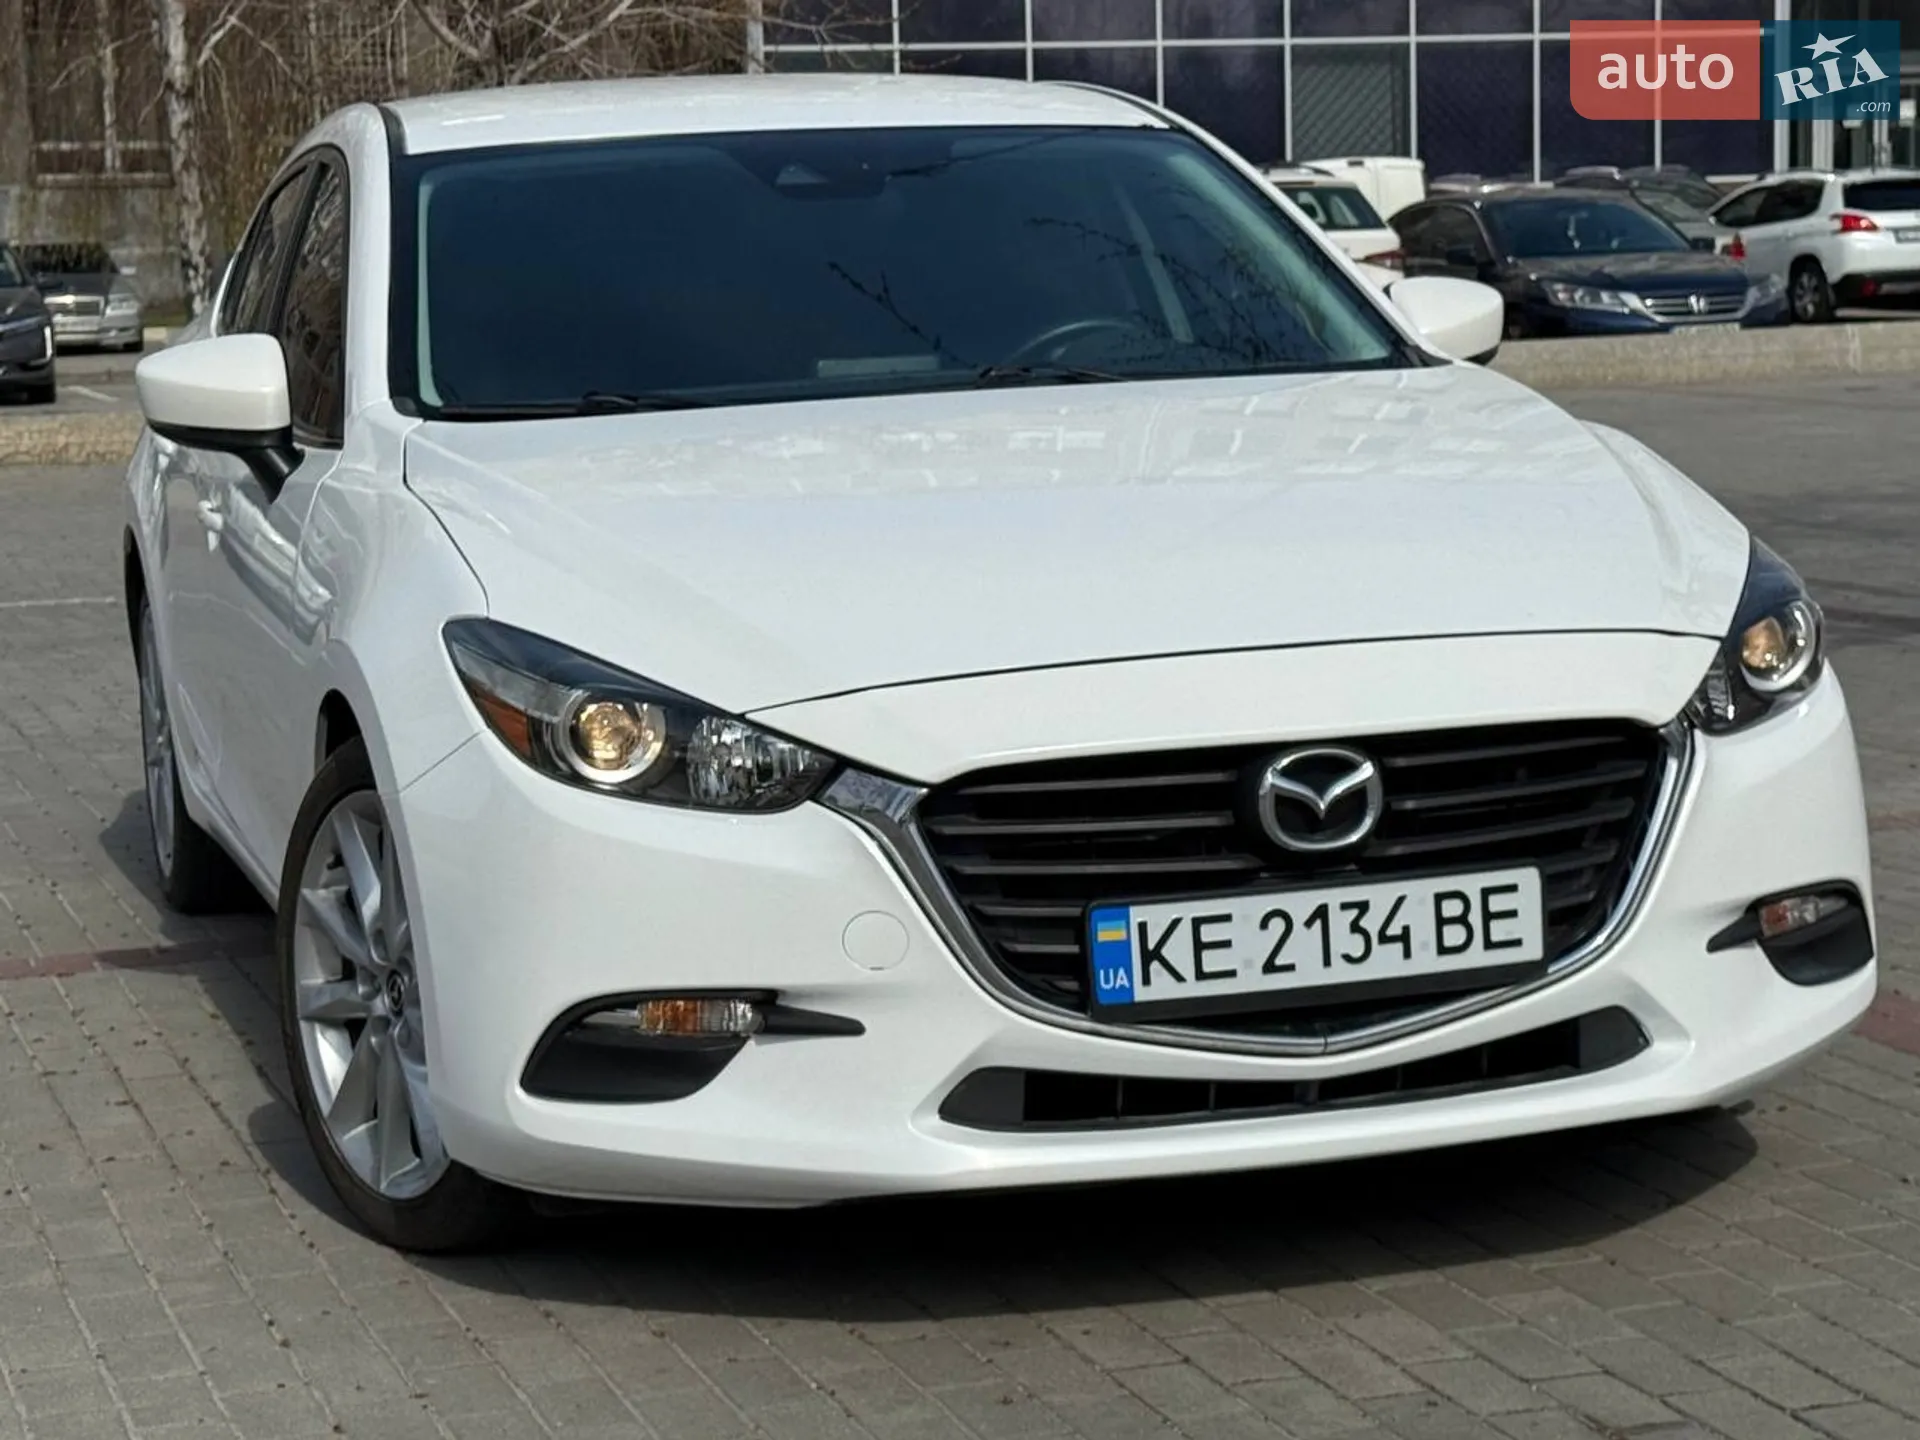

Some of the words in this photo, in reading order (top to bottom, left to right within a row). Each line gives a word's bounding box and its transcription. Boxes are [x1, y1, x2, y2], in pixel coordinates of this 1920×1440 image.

[1137, 912, 1237, 987] KE
[1259, 894, 1412, 975] 2134
[1434, 883, 1523, 957] BE
[1100, 969, 1130, 990] UA
